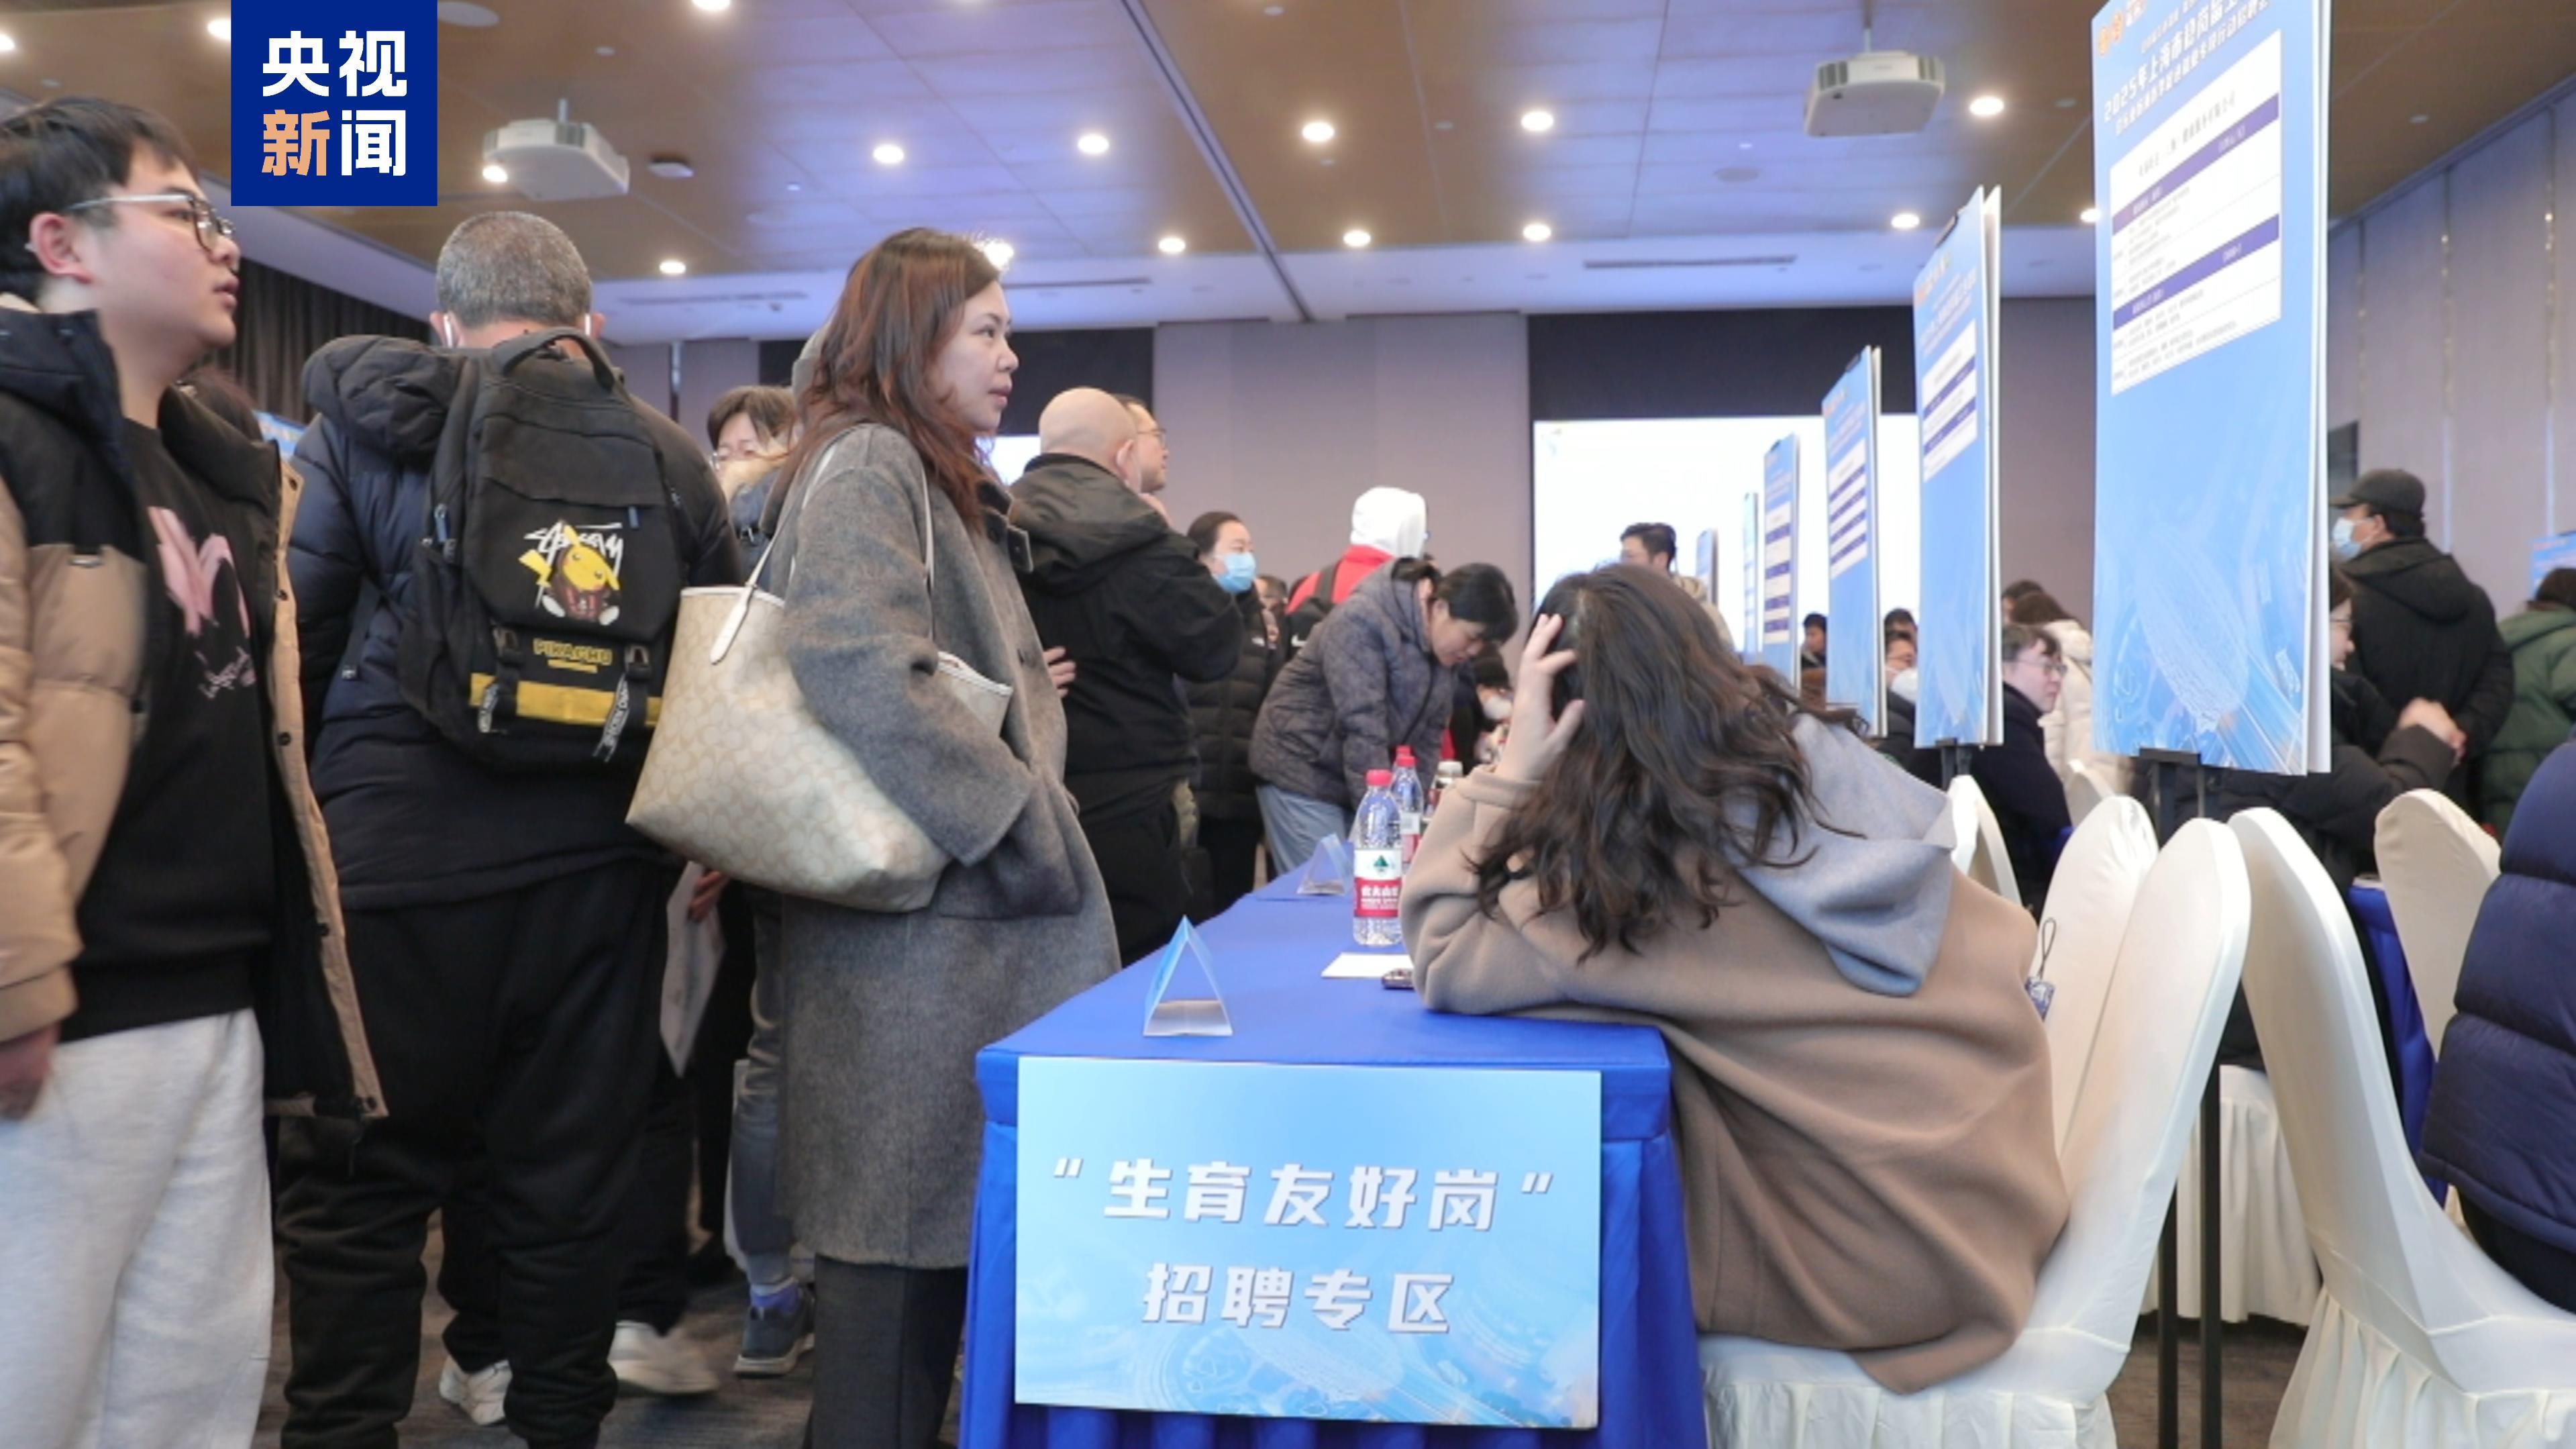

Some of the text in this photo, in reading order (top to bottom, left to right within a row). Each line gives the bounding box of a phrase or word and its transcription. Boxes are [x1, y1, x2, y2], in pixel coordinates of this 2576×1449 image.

[533, 638, 613, 666] PIKACHU
[1053, 1157, 1554, 1232] “生育友好岗”
[1142, 1261, 1454, 1334] 招聘专区
